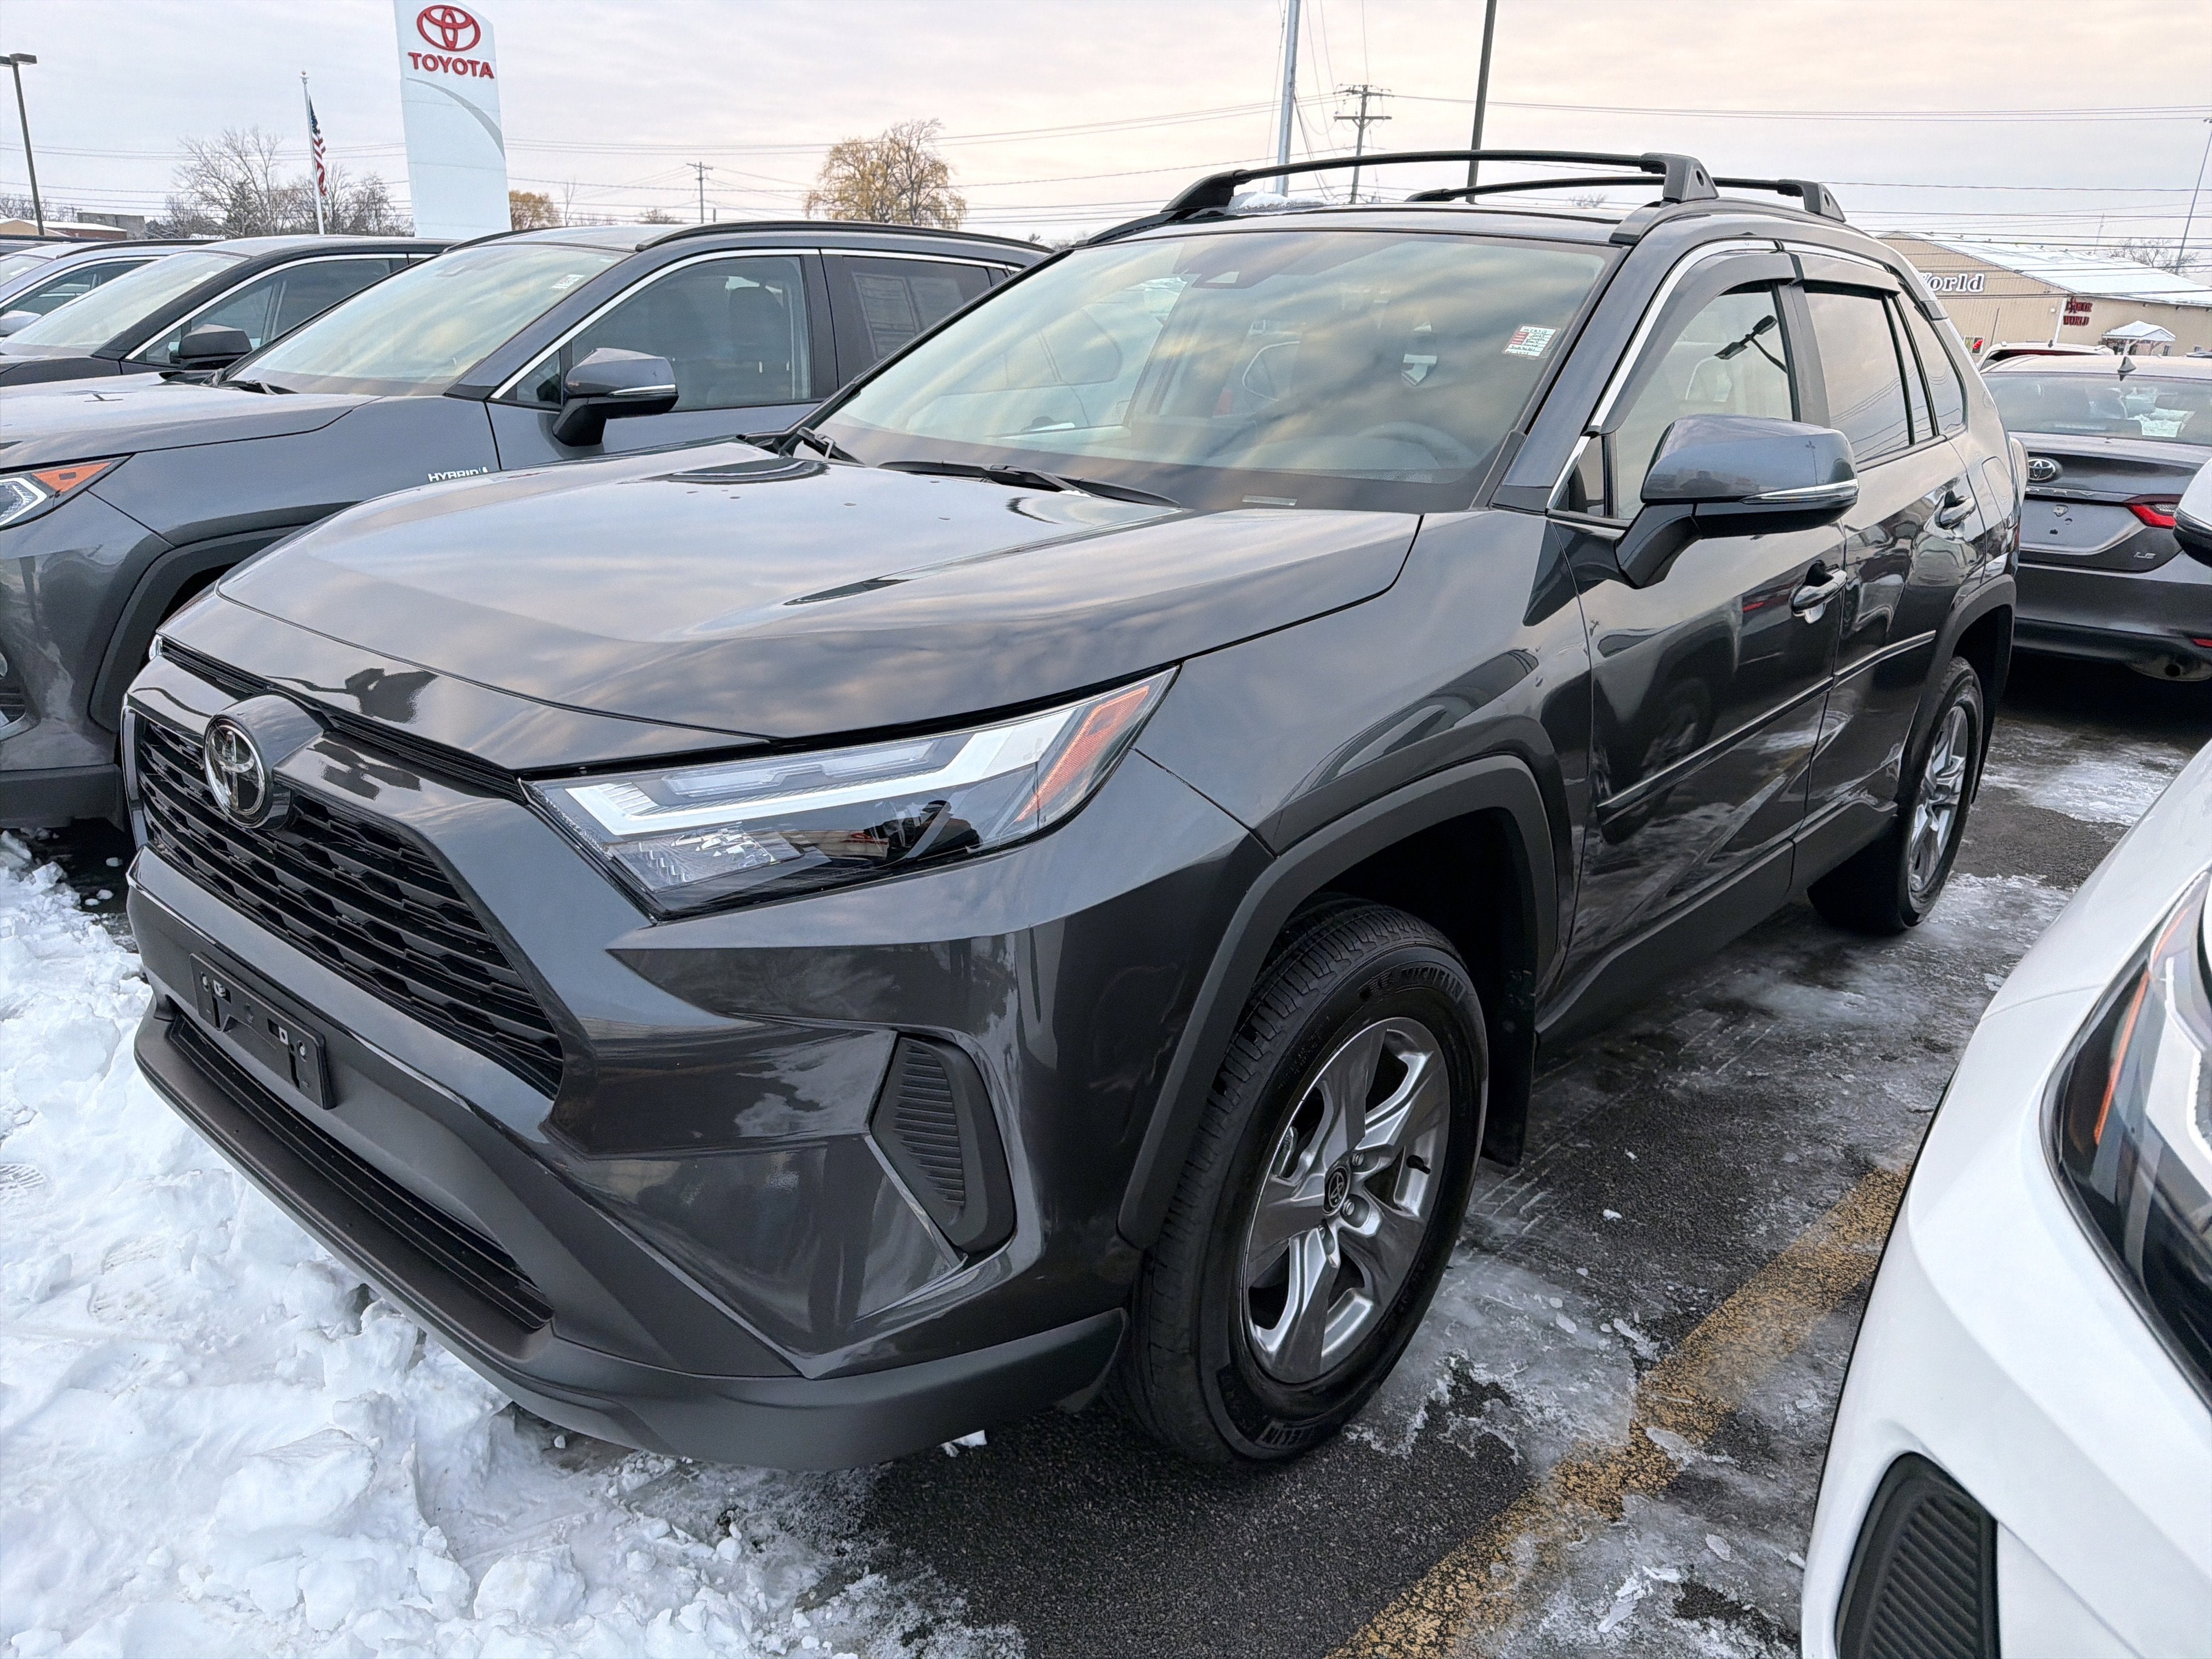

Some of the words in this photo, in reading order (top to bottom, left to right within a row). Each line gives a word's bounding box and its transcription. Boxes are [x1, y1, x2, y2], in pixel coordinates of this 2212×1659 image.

[407, 52, 495, 80] TOYOTA
[427, 469, 479, 482] HYBRID
[1400, 966, 1465, 1003] MICHELIN
